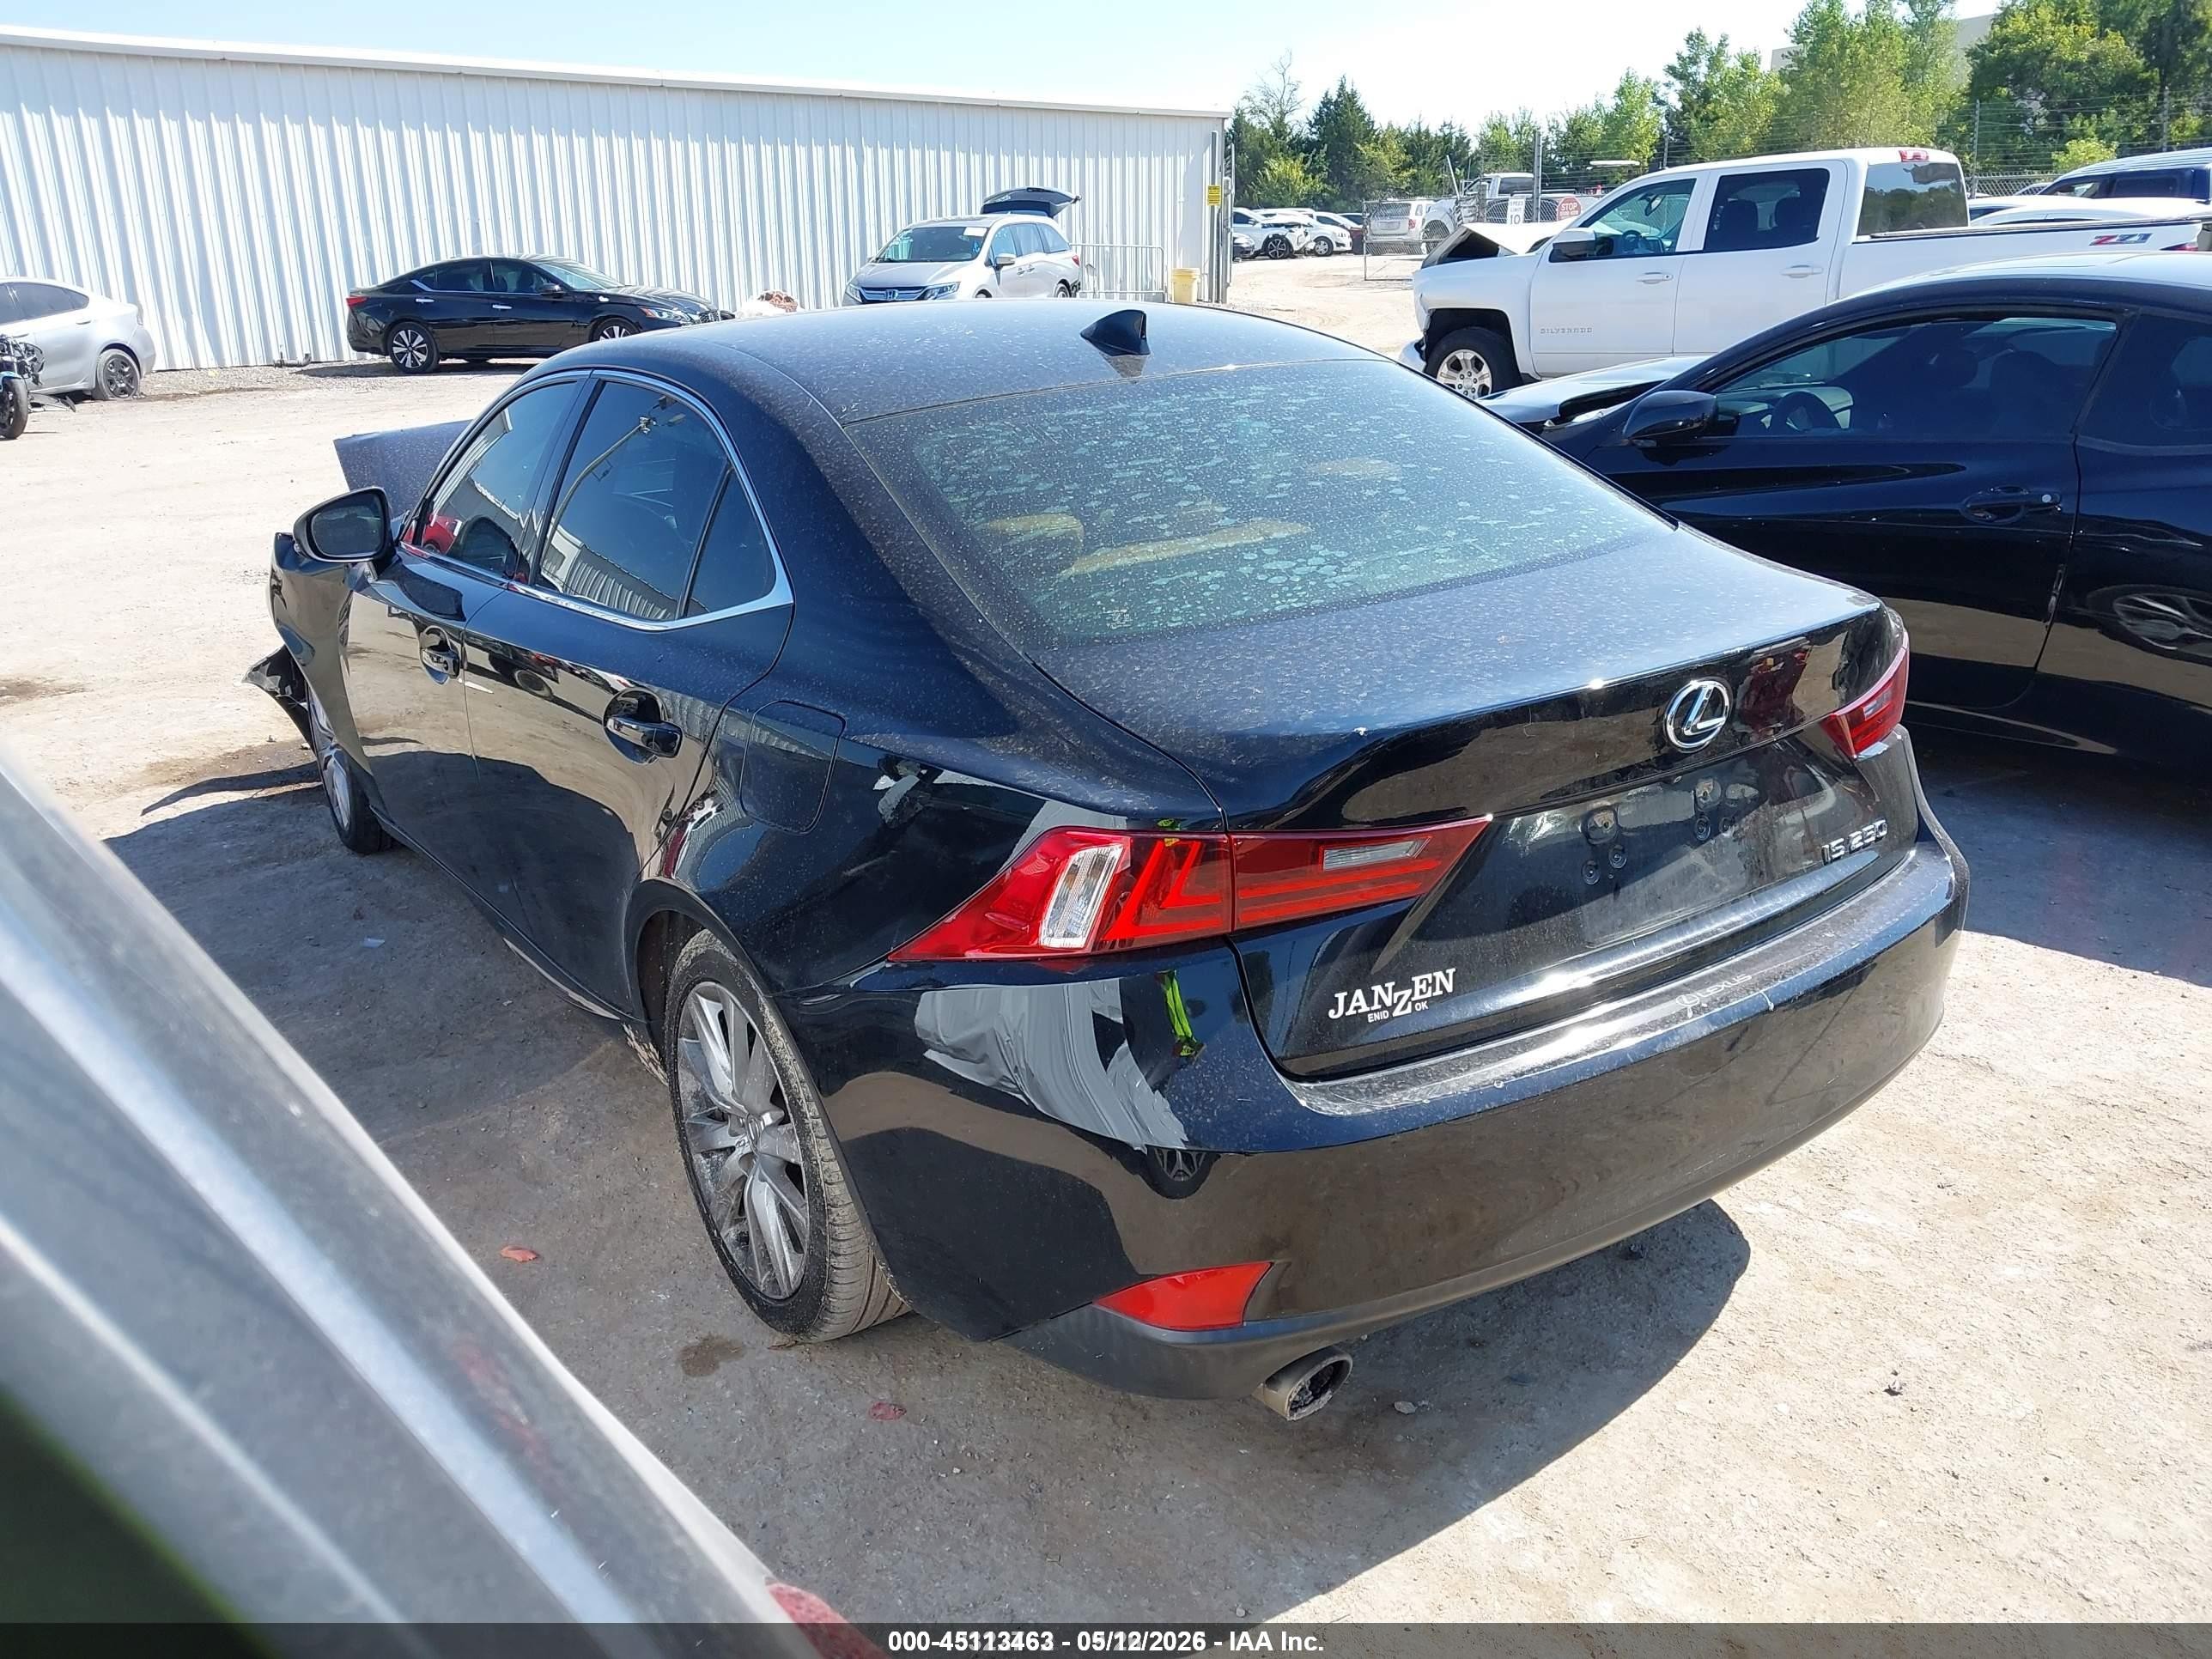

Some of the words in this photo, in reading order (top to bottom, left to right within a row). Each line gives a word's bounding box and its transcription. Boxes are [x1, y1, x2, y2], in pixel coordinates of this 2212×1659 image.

[1561, 202, 1577, 211] STOP
[1510, 215, 1521, 224] 10
[2088, 233, 2153, 246] Z71
[1821, 837, 1845, 866] IS
[1328, 968, 1456, 1019] JANZEN
[1696, 974, 1753, 997] LEXUS
[1367, 1010, 1389, 1023] ENID
[1414, 1001, 1429, 1012] OK
